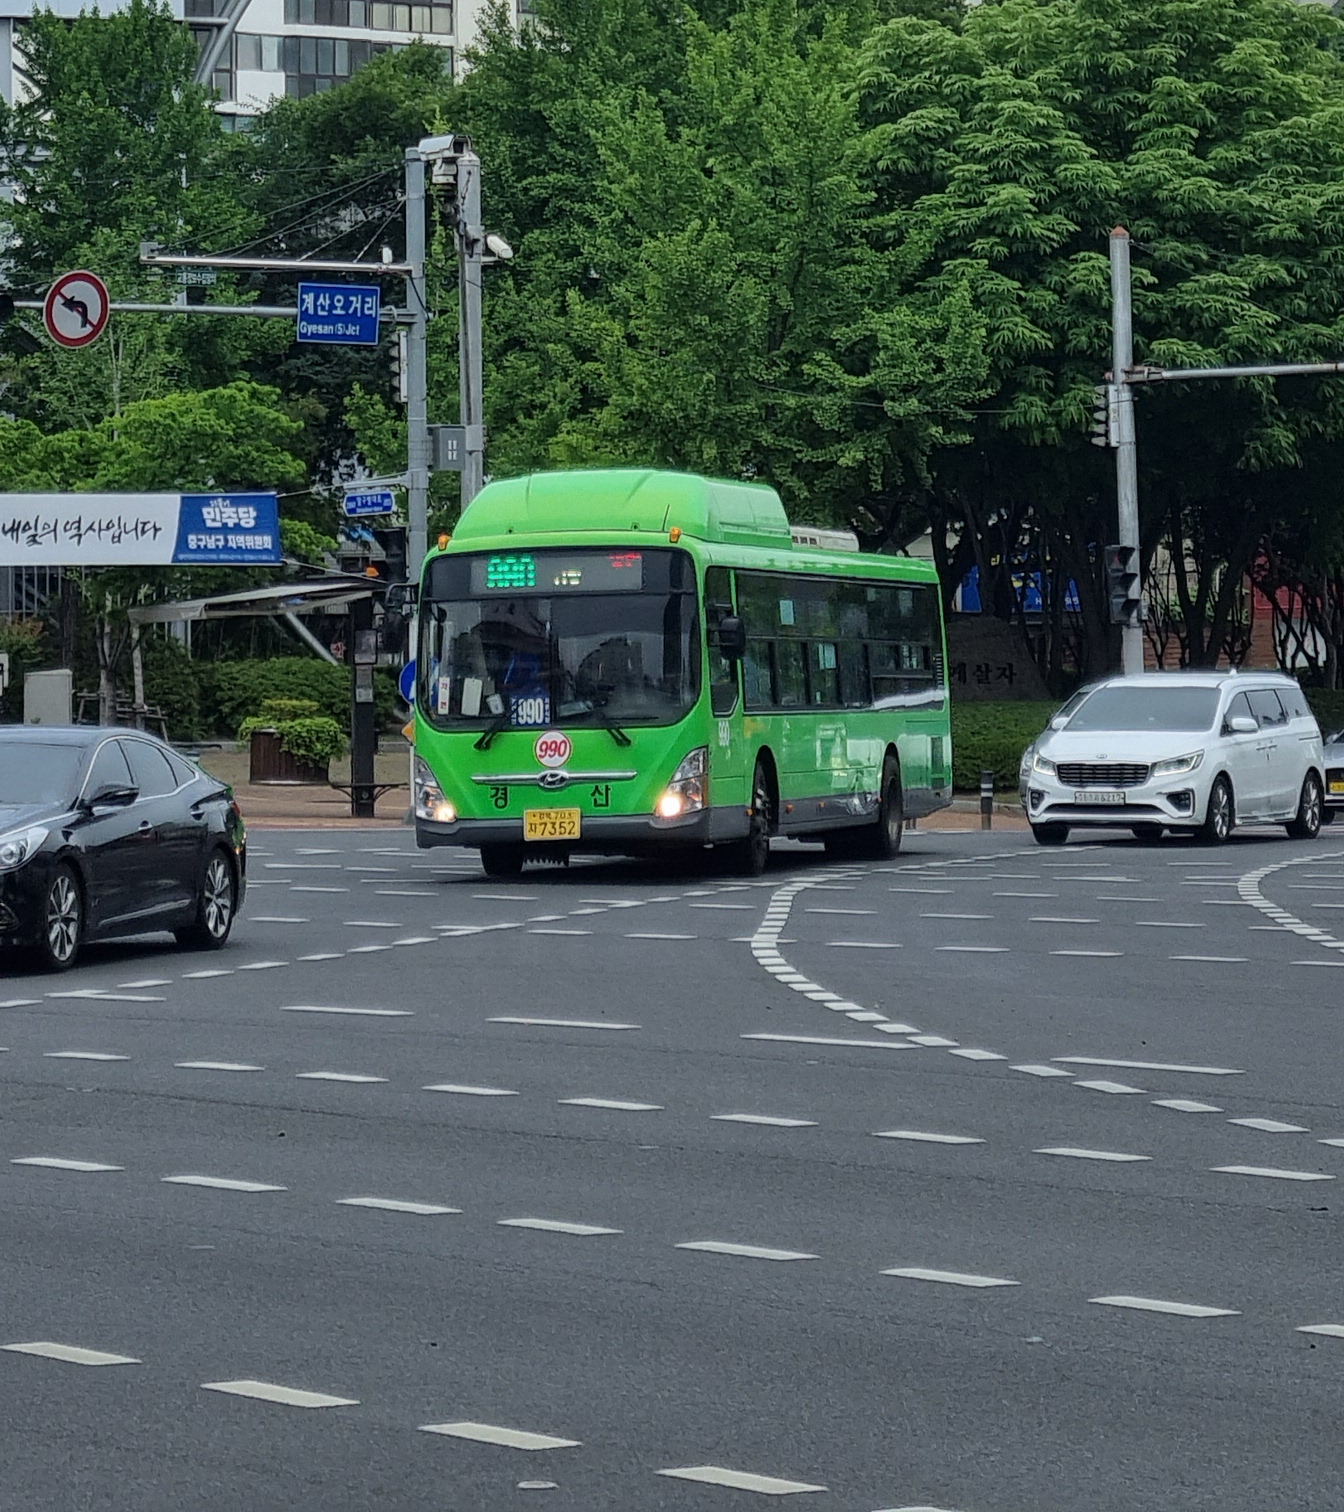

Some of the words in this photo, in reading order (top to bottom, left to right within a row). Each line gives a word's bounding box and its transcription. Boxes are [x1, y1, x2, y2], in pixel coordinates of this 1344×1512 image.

[301, 292, 377, 317] 계산오거리
[202, 506, 256, 528] 민주당
[2, 515, 58, 547] 내일의
[63, 515, 162, 546] 역사입니다
[188, 535, 224, 550] 중구남구
[227, 535, 272, 550] 지역위원회
[517, 699, 545, 725] 990
[718, 720, 730, 746] 990
[538, 740, 567, 759] 990
